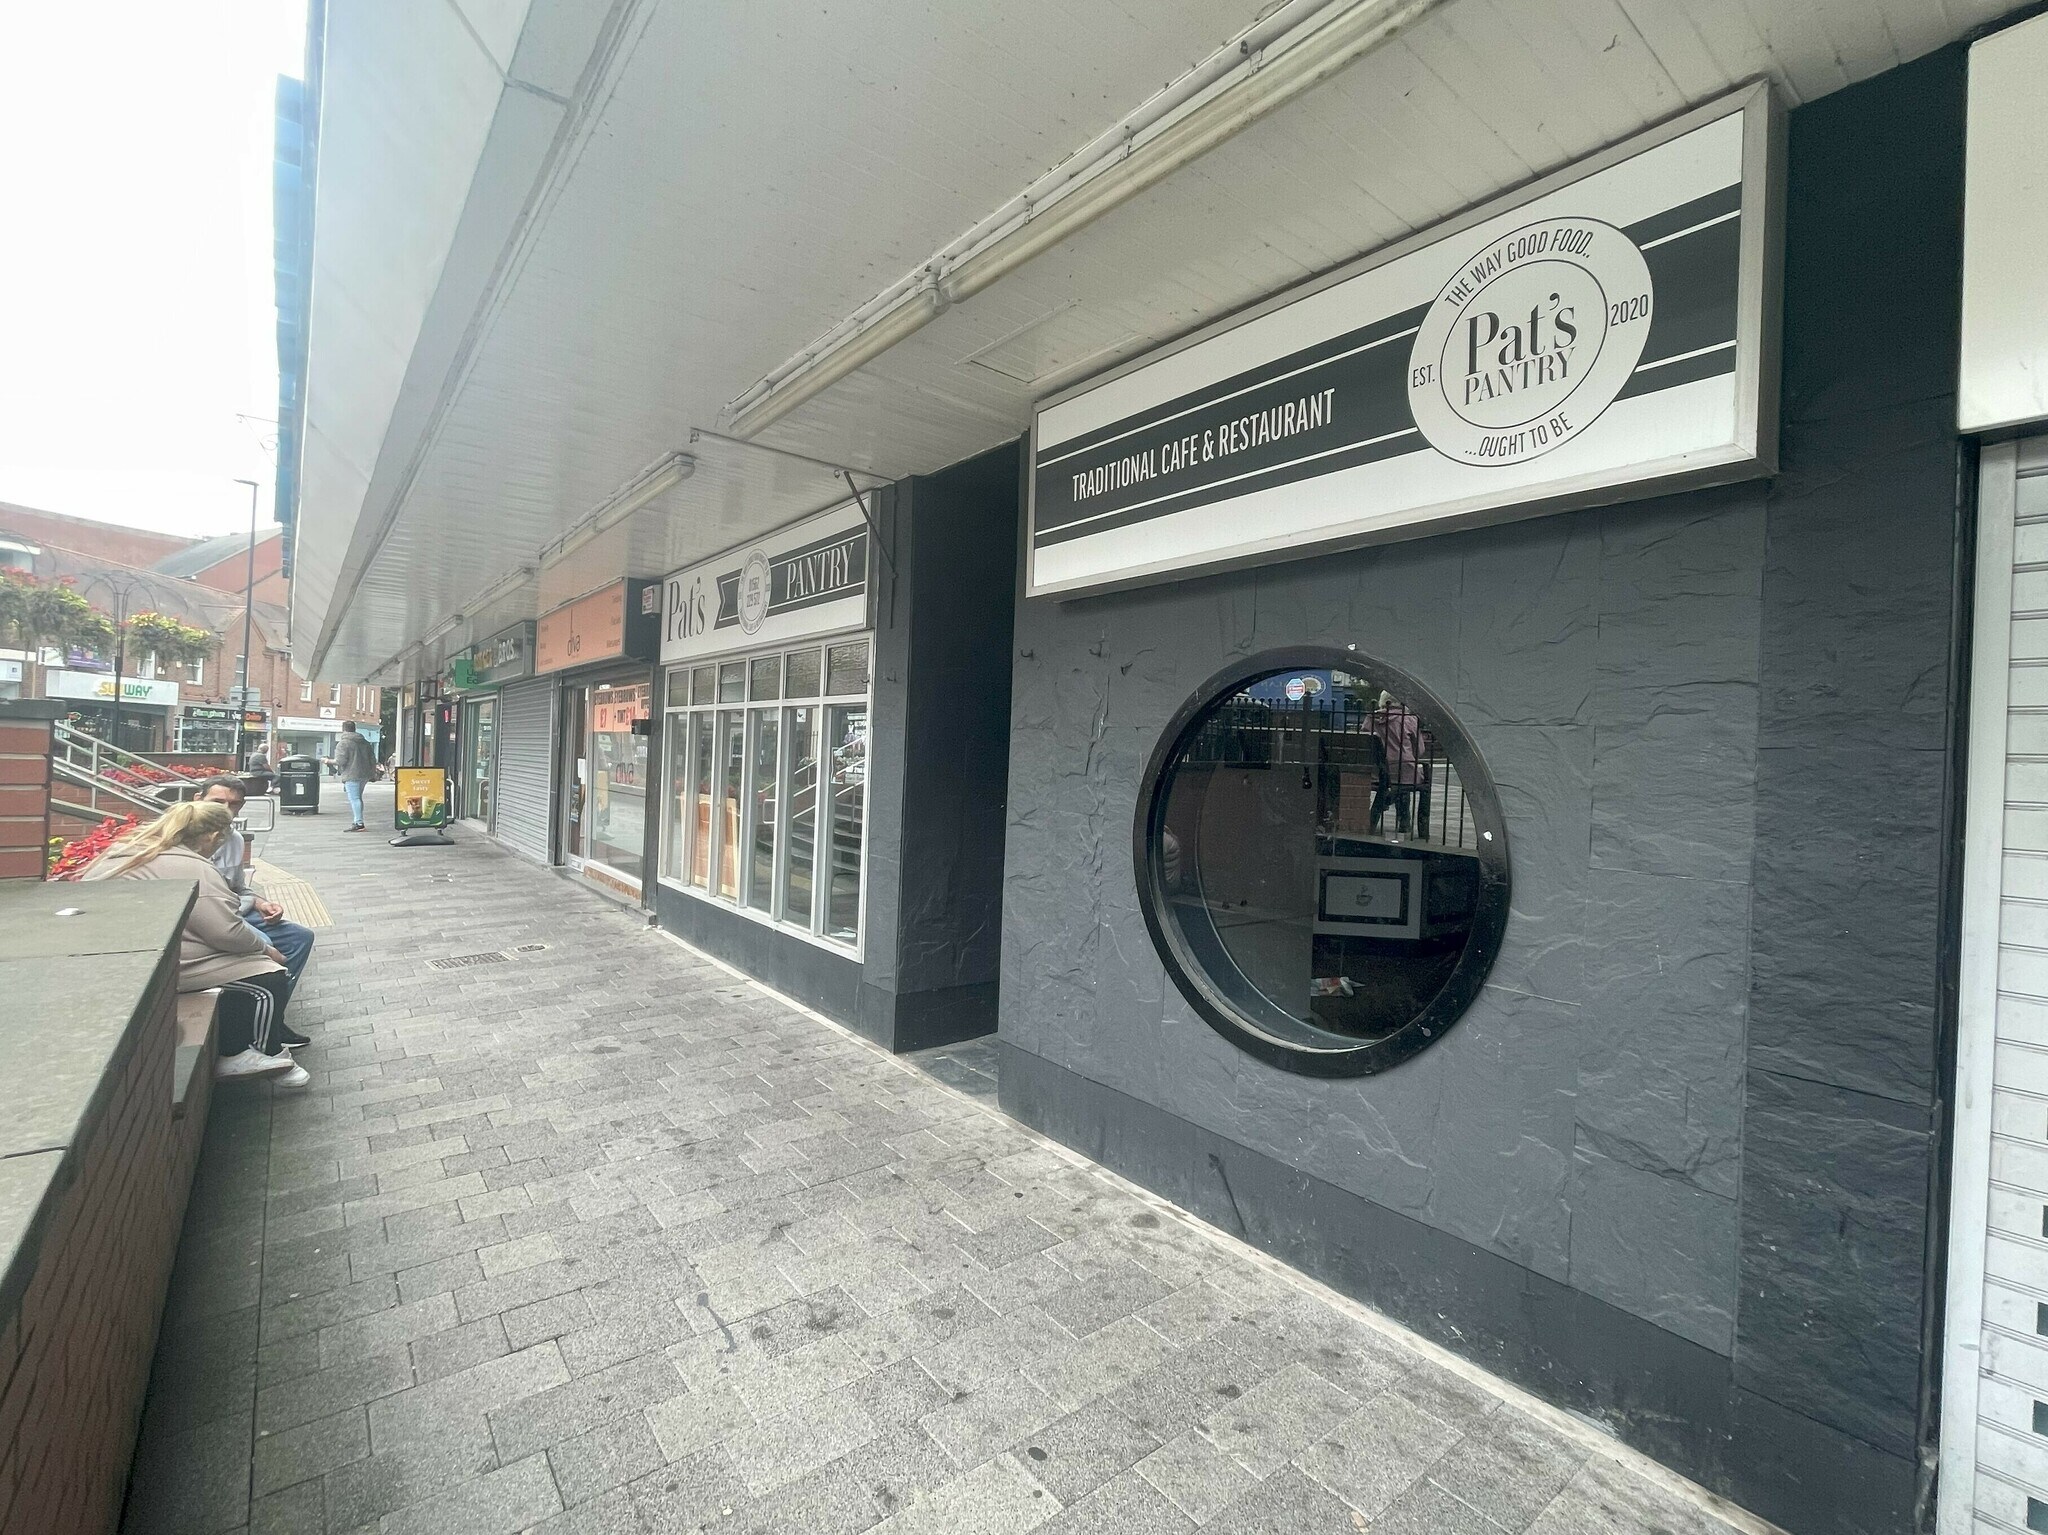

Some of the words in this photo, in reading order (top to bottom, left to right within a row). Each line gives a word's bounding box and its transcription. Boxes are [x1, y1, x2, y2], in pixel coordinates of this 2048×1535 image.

[1445, 278, 1474, 307] THE
[1470, 248, 1504, 284] WAY
[1507, 230, 1549, 263] GOOD
[1465, 292, 1577, 377] Pat's
[1610, 294, 1649, 327] 2020
[1412, 363, 1436, 389] EST.
[1463, 347, 1577, 407] PANTRY
[1072, 448, 1158, 502] TRADITIONAL
[1161, 433, 1199, 475] CAFE
[1202, 429, 1214, 463] &
[1218, 388, 1335, 458] RESTAURANT
[1528, 424, 1549, 449] TO
[1550, 411, 1574, 438] BE
[667, 576, 706, 642] Pat's
[785, 542, 855, 600] PANTRY
